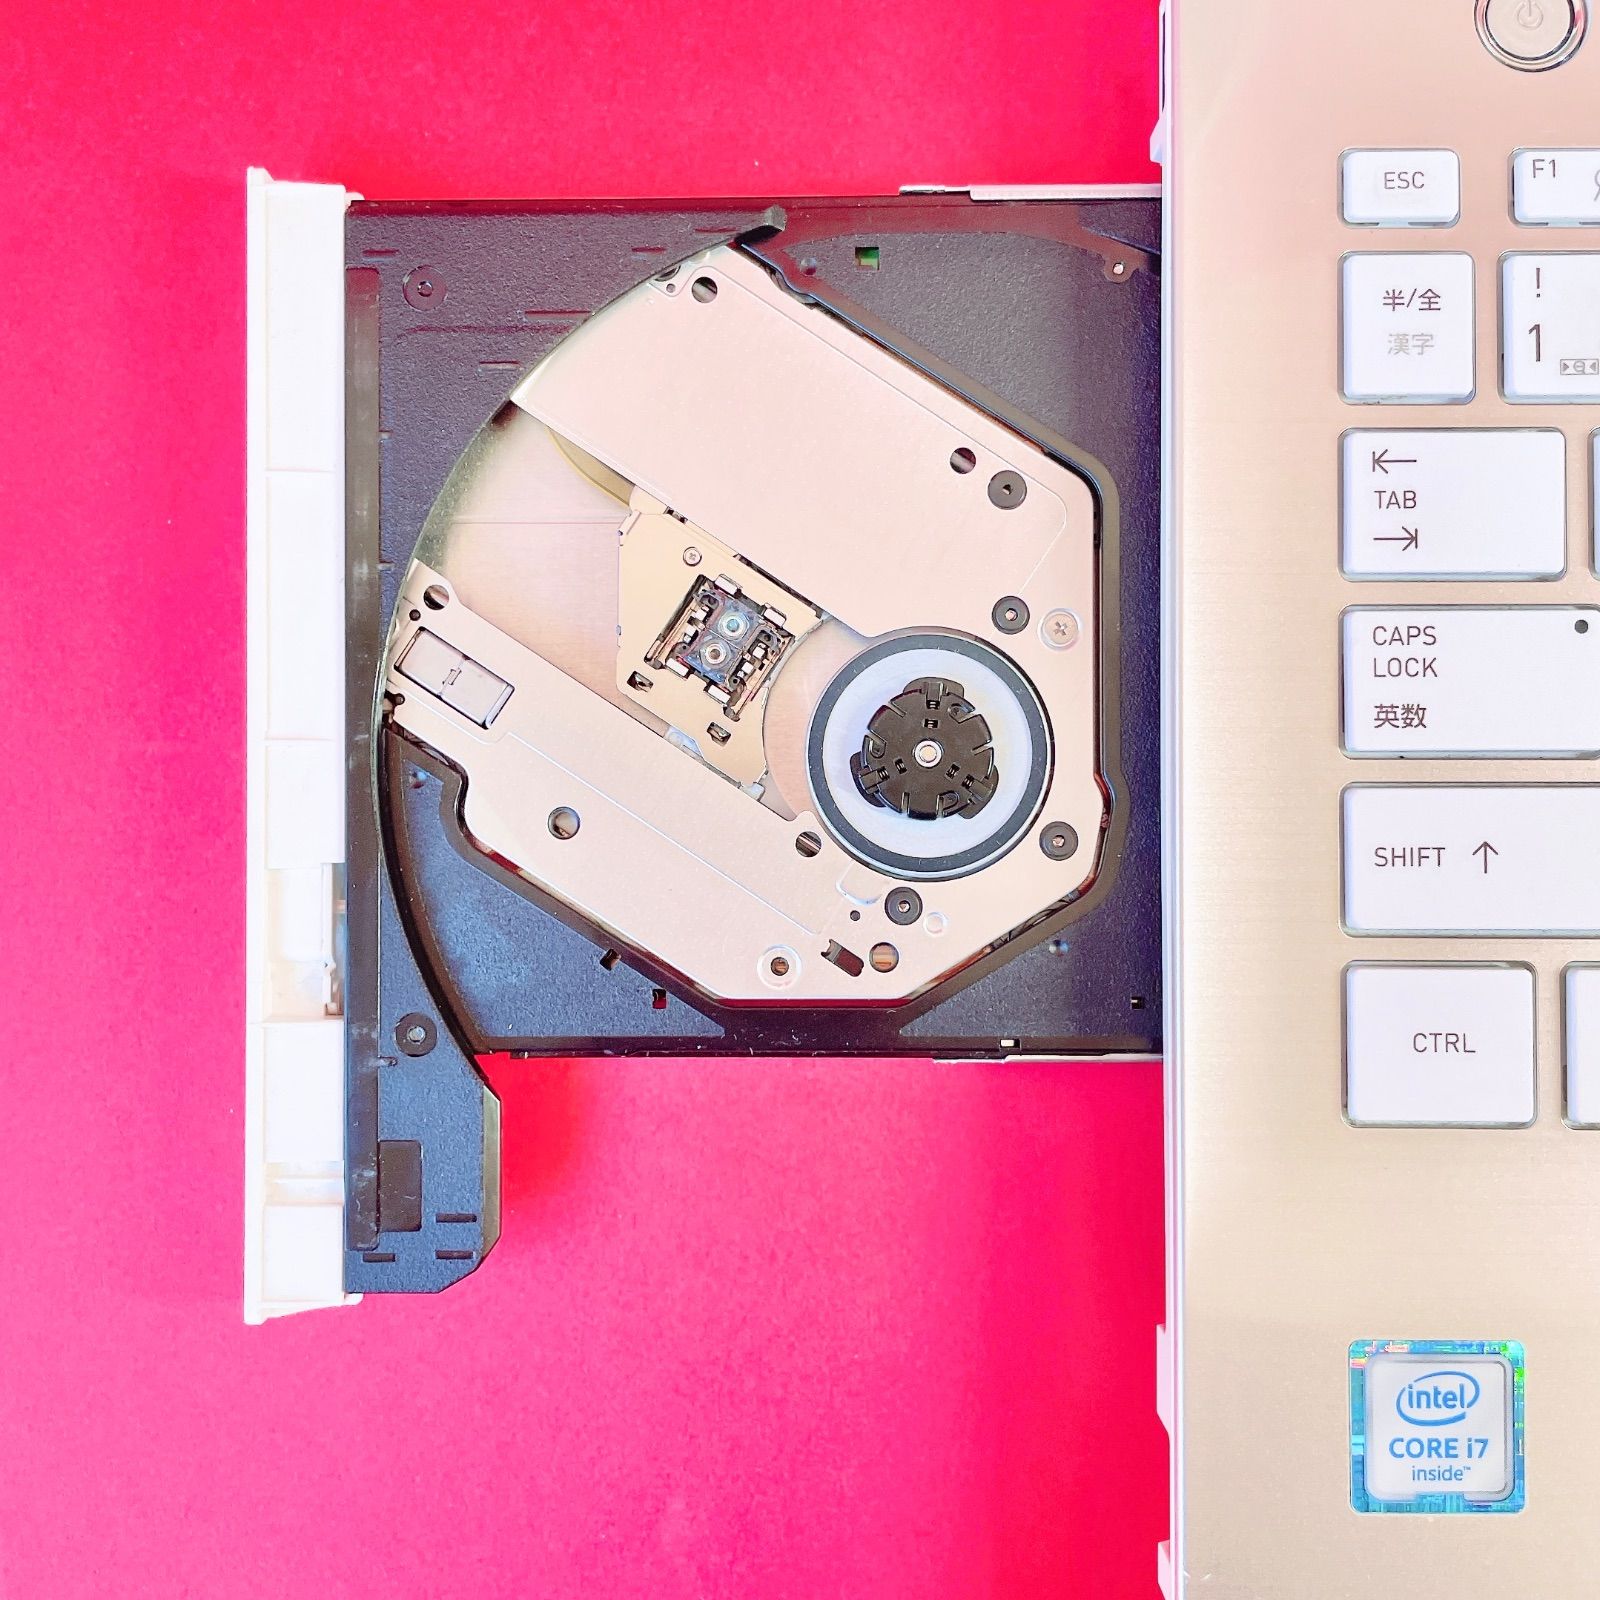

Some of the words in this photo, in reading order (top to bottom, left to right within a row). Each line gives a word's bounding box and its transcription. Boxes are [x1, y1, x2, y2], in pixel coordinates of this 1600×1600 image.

[1532, 158, 1556, 179] F1
[1383, 170, 1425, 190] ESC
[1534, 267, 1543, 300] !
[1382, 287, 1442, 312] 半/全
[1387, 332, 1435, 356] 漢字
[1528, 323, 1543, 364] 1
[1373, 490, 1417, 510] TAB
[1372, 625, 1437, 646] CAPS
[1373, 657, 1438, 678] LOCK
[1373, 703, 1427, 729] 英数
[1374, 846, 1446, 868] SHIFT
[1413, 1032, 1477, 1054] CTRL
[1406, 1382, 1467, 1410] intel
[1388, 1437, 1459, 1459] CORE
[1466, 1437, 1489, 1459] i7
